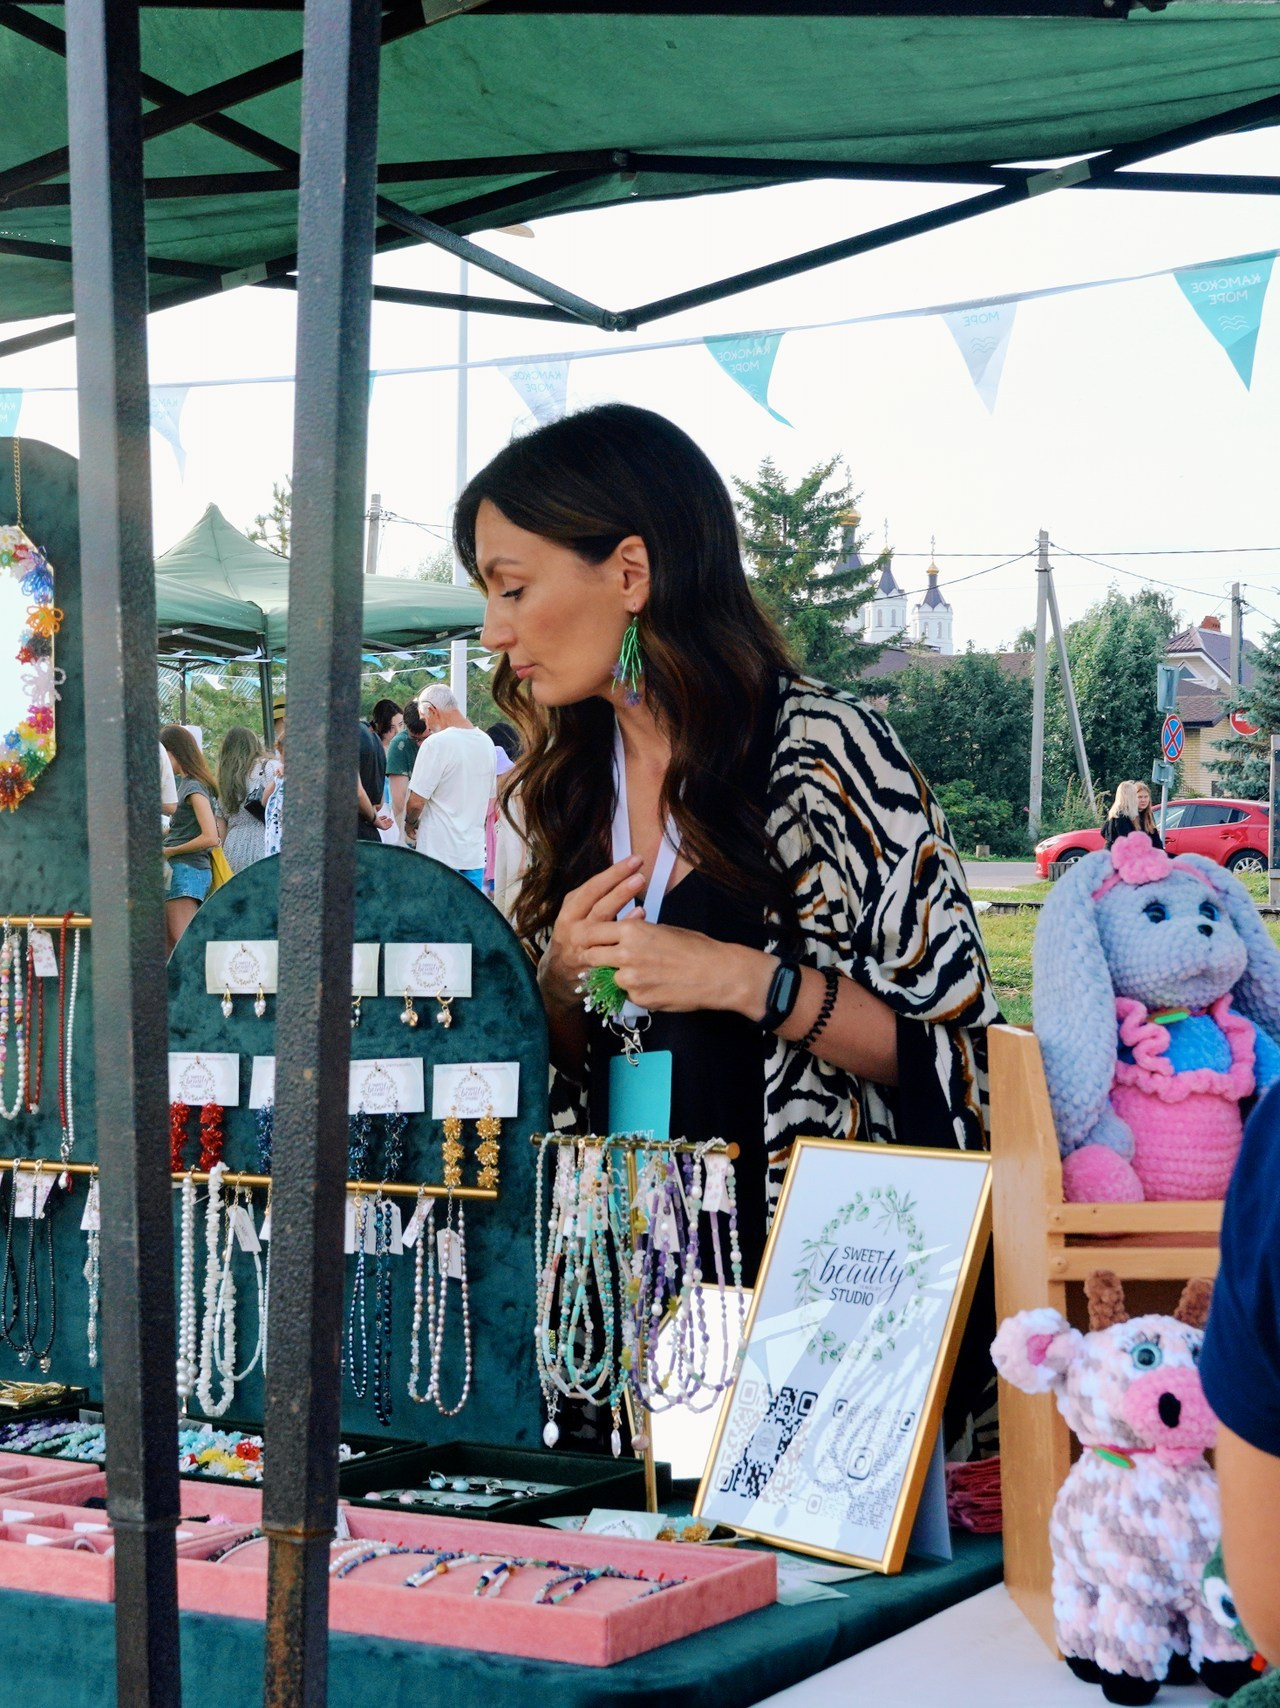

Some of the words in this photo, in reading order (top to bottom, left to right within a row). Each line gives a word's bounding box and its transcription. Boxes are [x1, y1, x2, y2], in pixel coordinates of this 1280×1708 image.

[842, 1246, 885, 1263] SWEET
[819, 1247, 904, 1306] beauty
[829, 1287, 874, 1306] STUDIO
